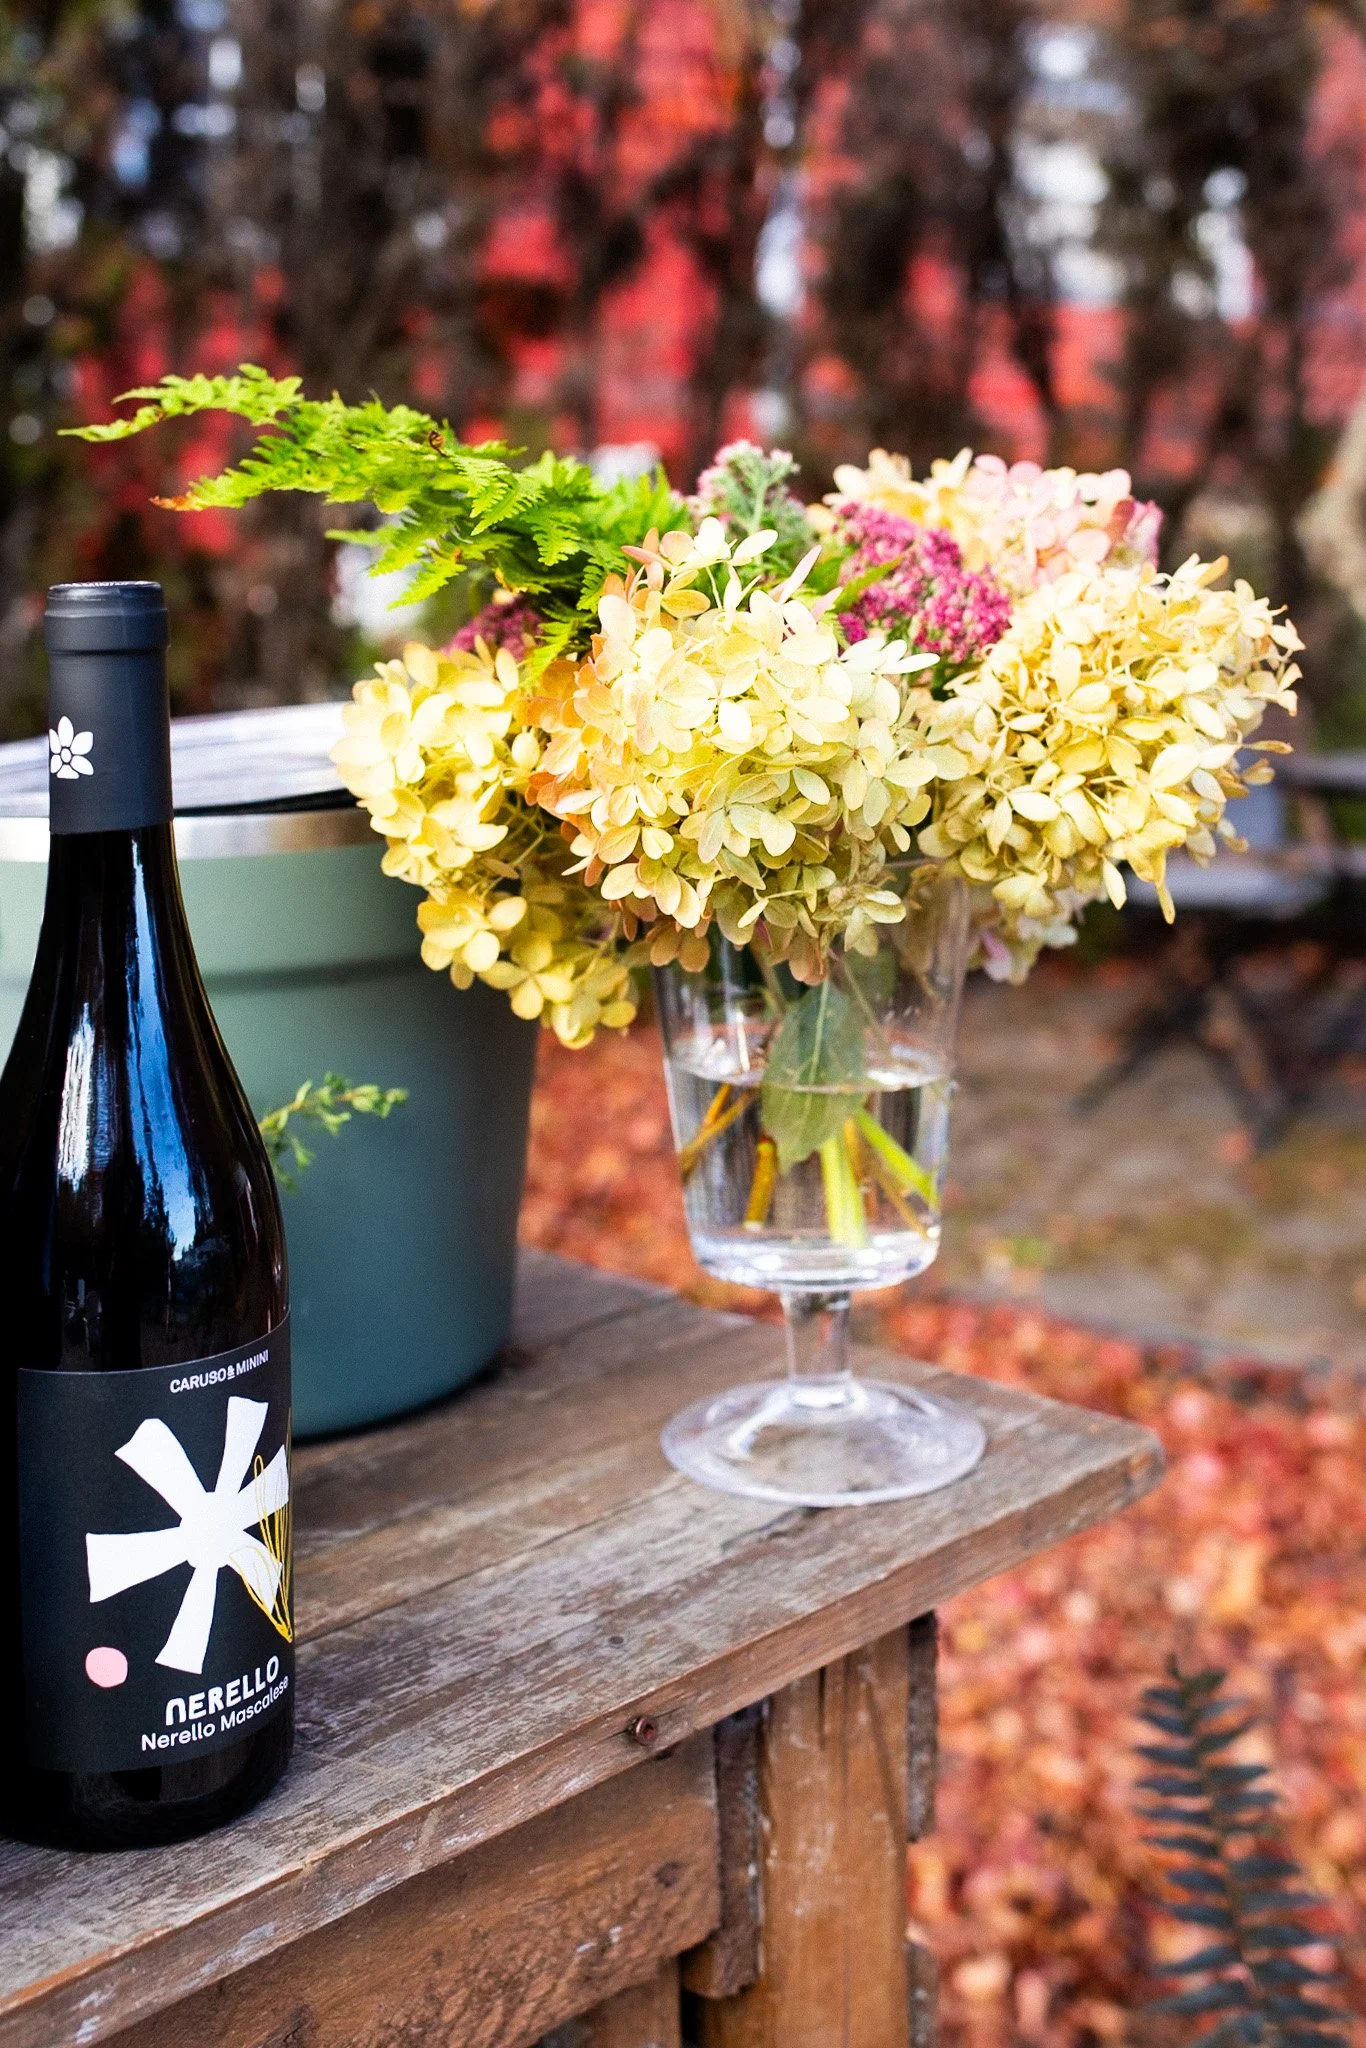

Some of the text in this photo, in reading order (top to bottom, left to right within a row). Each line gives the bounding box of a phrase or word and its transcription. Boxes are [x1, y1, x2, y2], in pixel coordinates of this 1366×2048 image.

[169, 1367, 227, 1394] CARUSO
[236, 1349, 269, 1376] MININI
[141, 1675, 289, 1752] Nerello Mascalese
[165, 1655, 280, 1726] NERELLO
